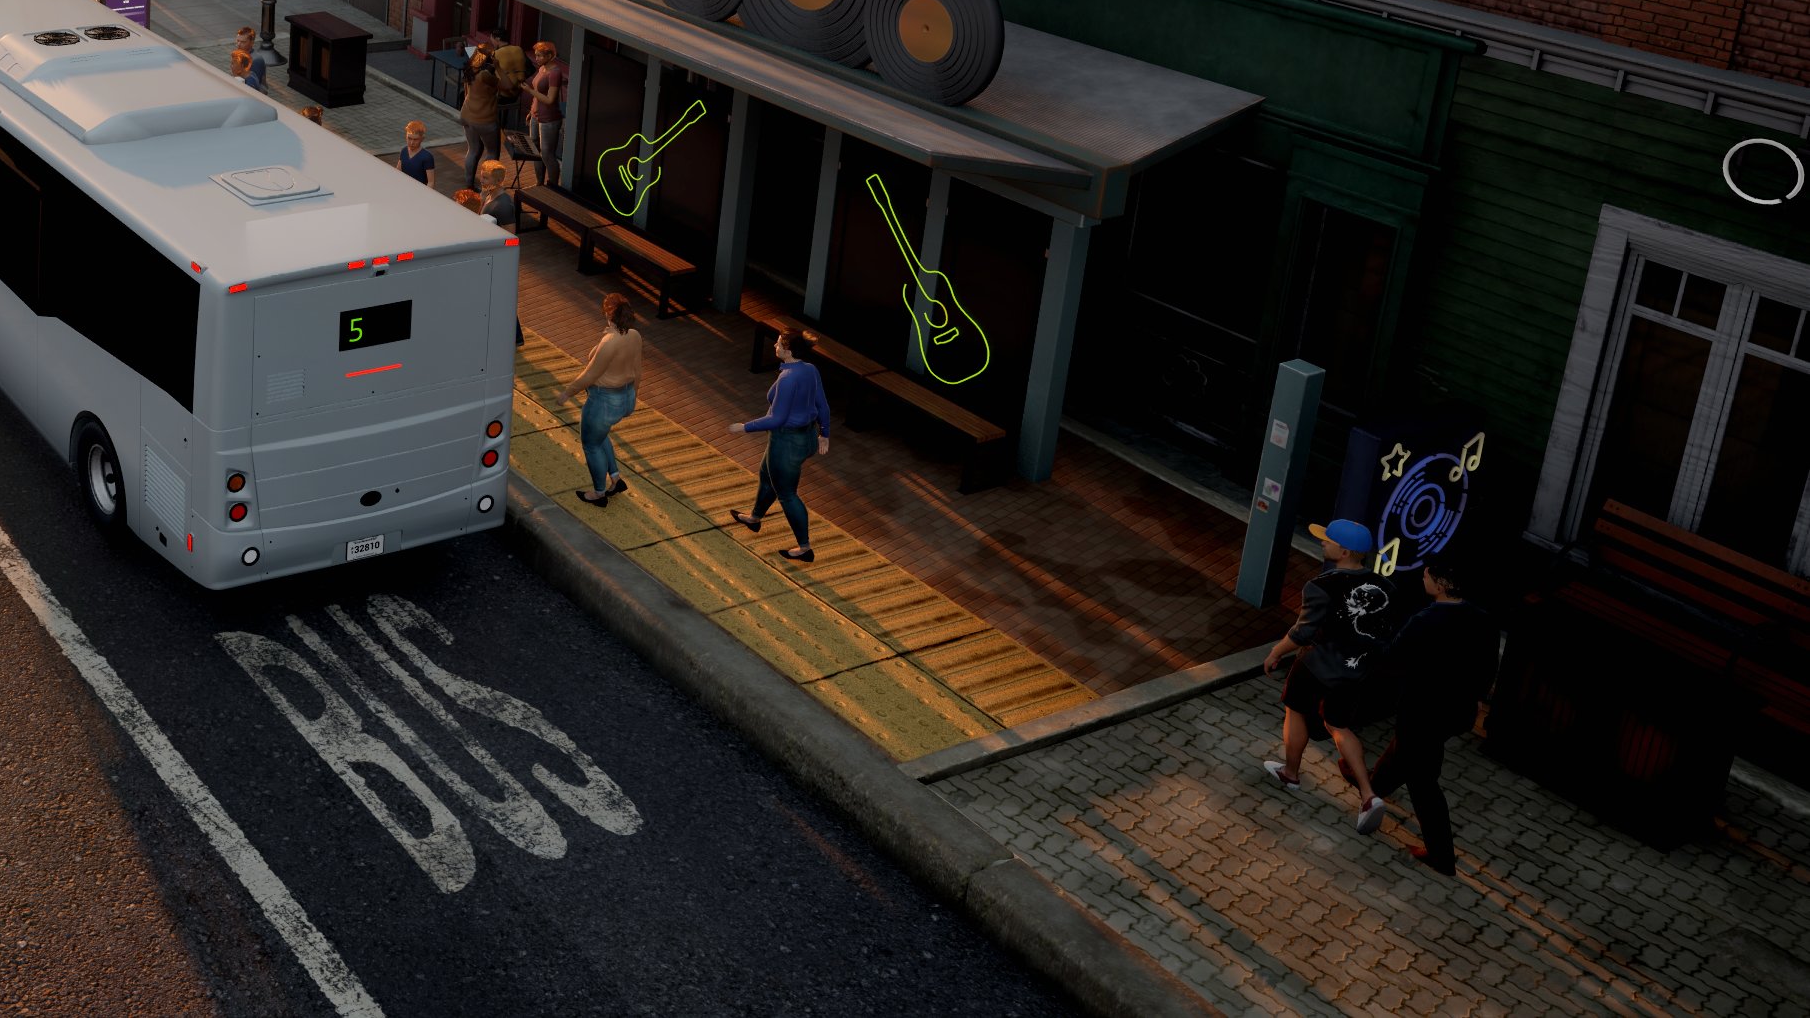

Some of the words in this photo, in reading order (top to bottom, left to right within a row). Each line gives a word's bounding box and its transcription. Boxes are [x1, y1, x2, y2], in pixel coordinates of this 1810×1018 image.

[348, 317, 363, 343] 5
[354, 541, 380, 554] 32810
[213, 593, 644, 894] BUS
